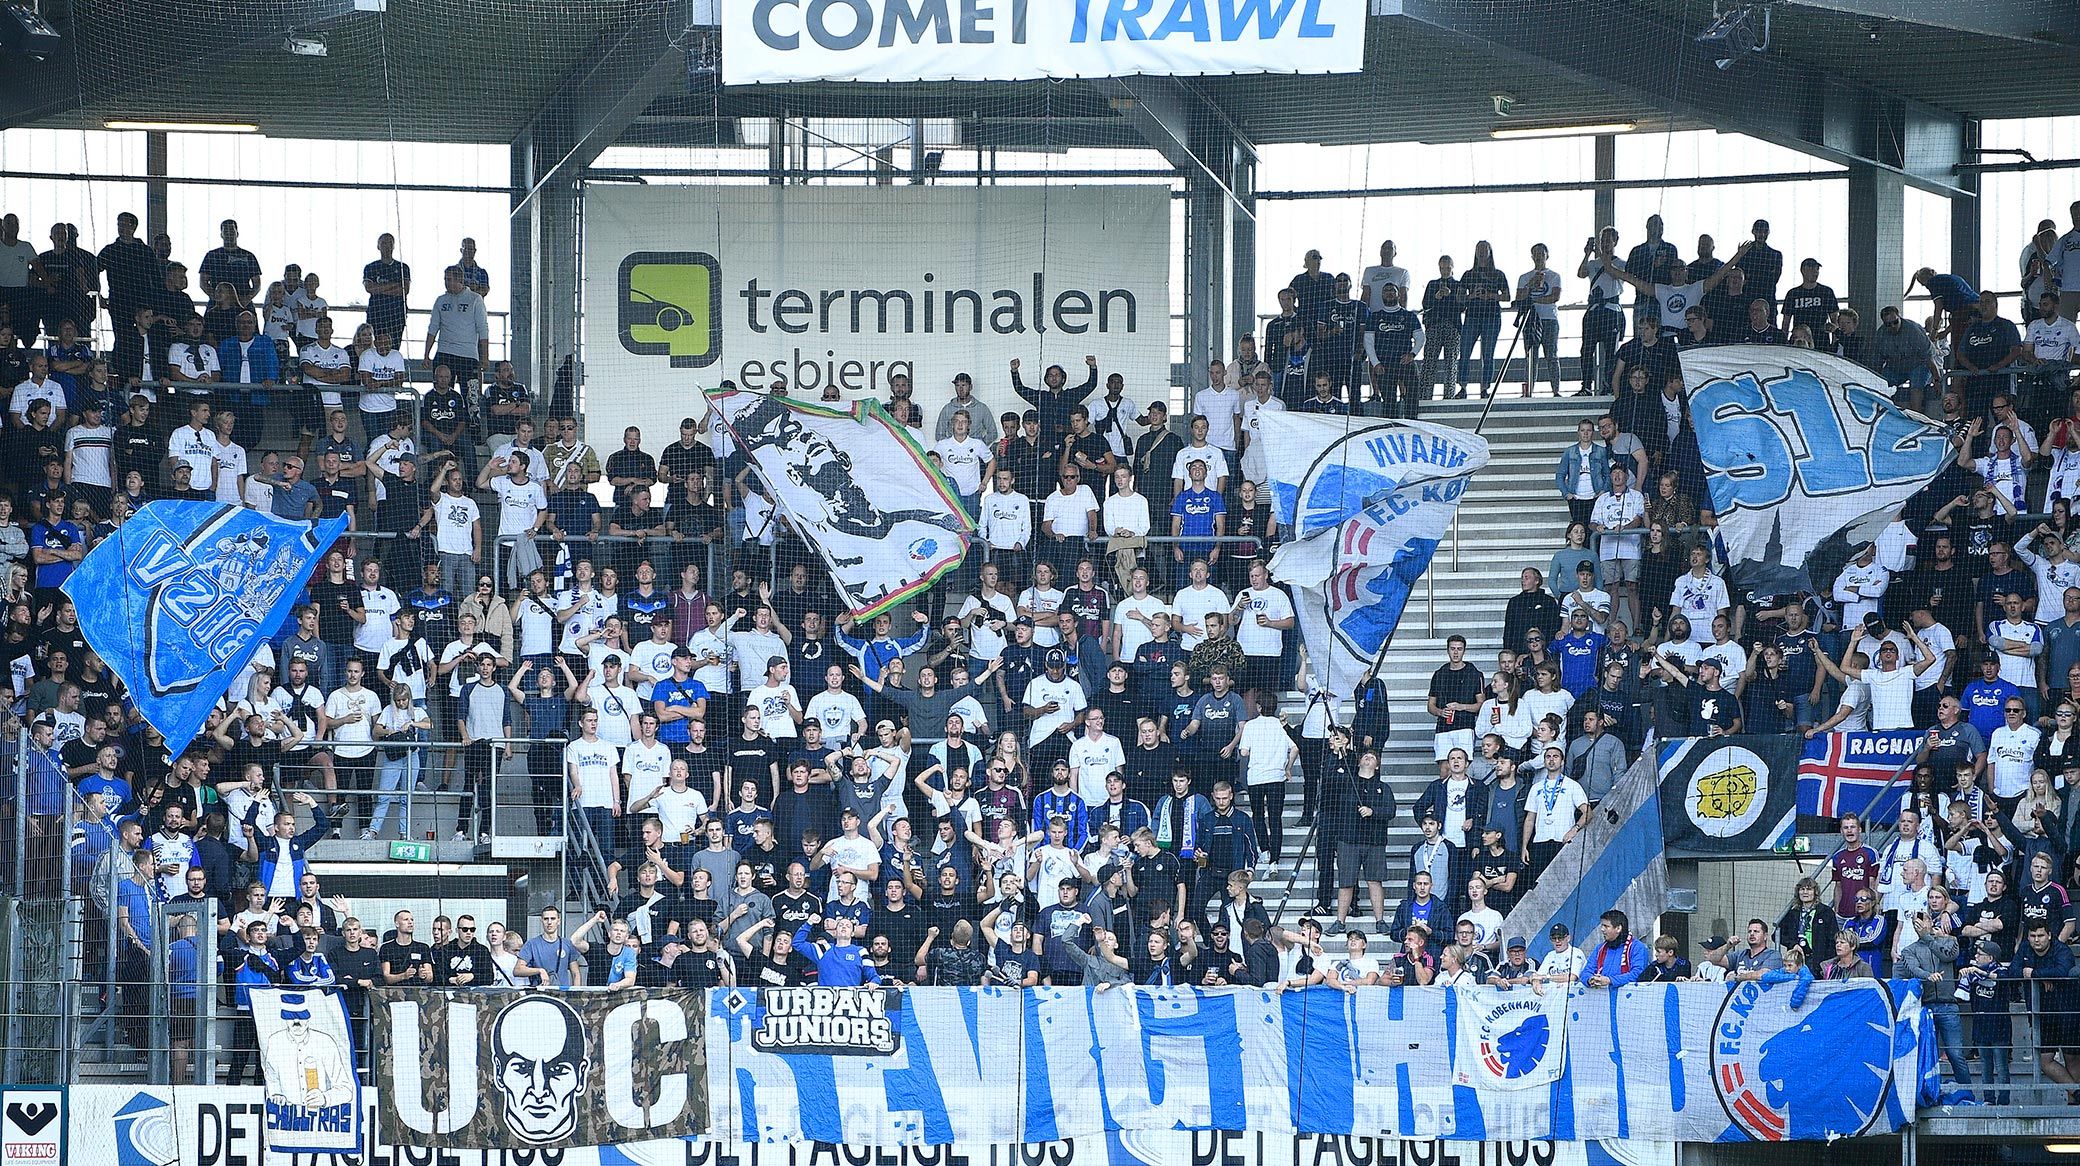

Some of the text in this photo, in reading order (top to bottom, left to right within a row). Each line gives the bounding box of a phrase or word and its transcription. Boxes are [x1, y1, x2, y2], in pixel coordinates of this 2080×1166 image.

[740, 272, 1136, 334] terminalen
[1795, 297, 1821, 308] 1128
[1379, 322, 1405, 331] Carlsberg
[1969, 335, 1992, 346] Carlsberg
[2035, 336, 2058, 347] Carlsberg
[431, 408, 455, 420] Carlsberg
[948, 454, 973, 464] Carlsberg
[504, 496, 528, 508] Carlsberg
[994, 509, 1017, 520] Carlsberg
[1186, 503, 1210, 514] Carlsberg
[1968, 546, 1989, 555] DNA
[1849, 576, 1870, 585] Carlsberg
[418, 609, 443, 621] Carlsberg
[1071, 604, 1099, 616] Carlsberg
[1568, 646, 1591, 656] Carlsberg
[1972, 695, 1998, 706] Carlsberg
[1205, 708, 1229, 720] Carlsberg
[57, 722, 80, 740] 25
[1997, 746, 2023, 758] Carlsberg
[635, 760, 660, 772] Carlsberg
[1085, 755, 1108, 766] Carlsberg
[980, 804, 1007, 816] Carlsberg
[1842, 867, 1864, 878] Carlsberg
[1976, 986, 1994, 998] Carlsberg
[768, 989, 885, 1018] URBAN
[757, 1016, 890, 1046] JUNIORS
[267, 1100, 351, 1133] CHILLTRAS
[199, 1103, 264, 1166] DET
[5, 1143, 56, 1158] VIKING
